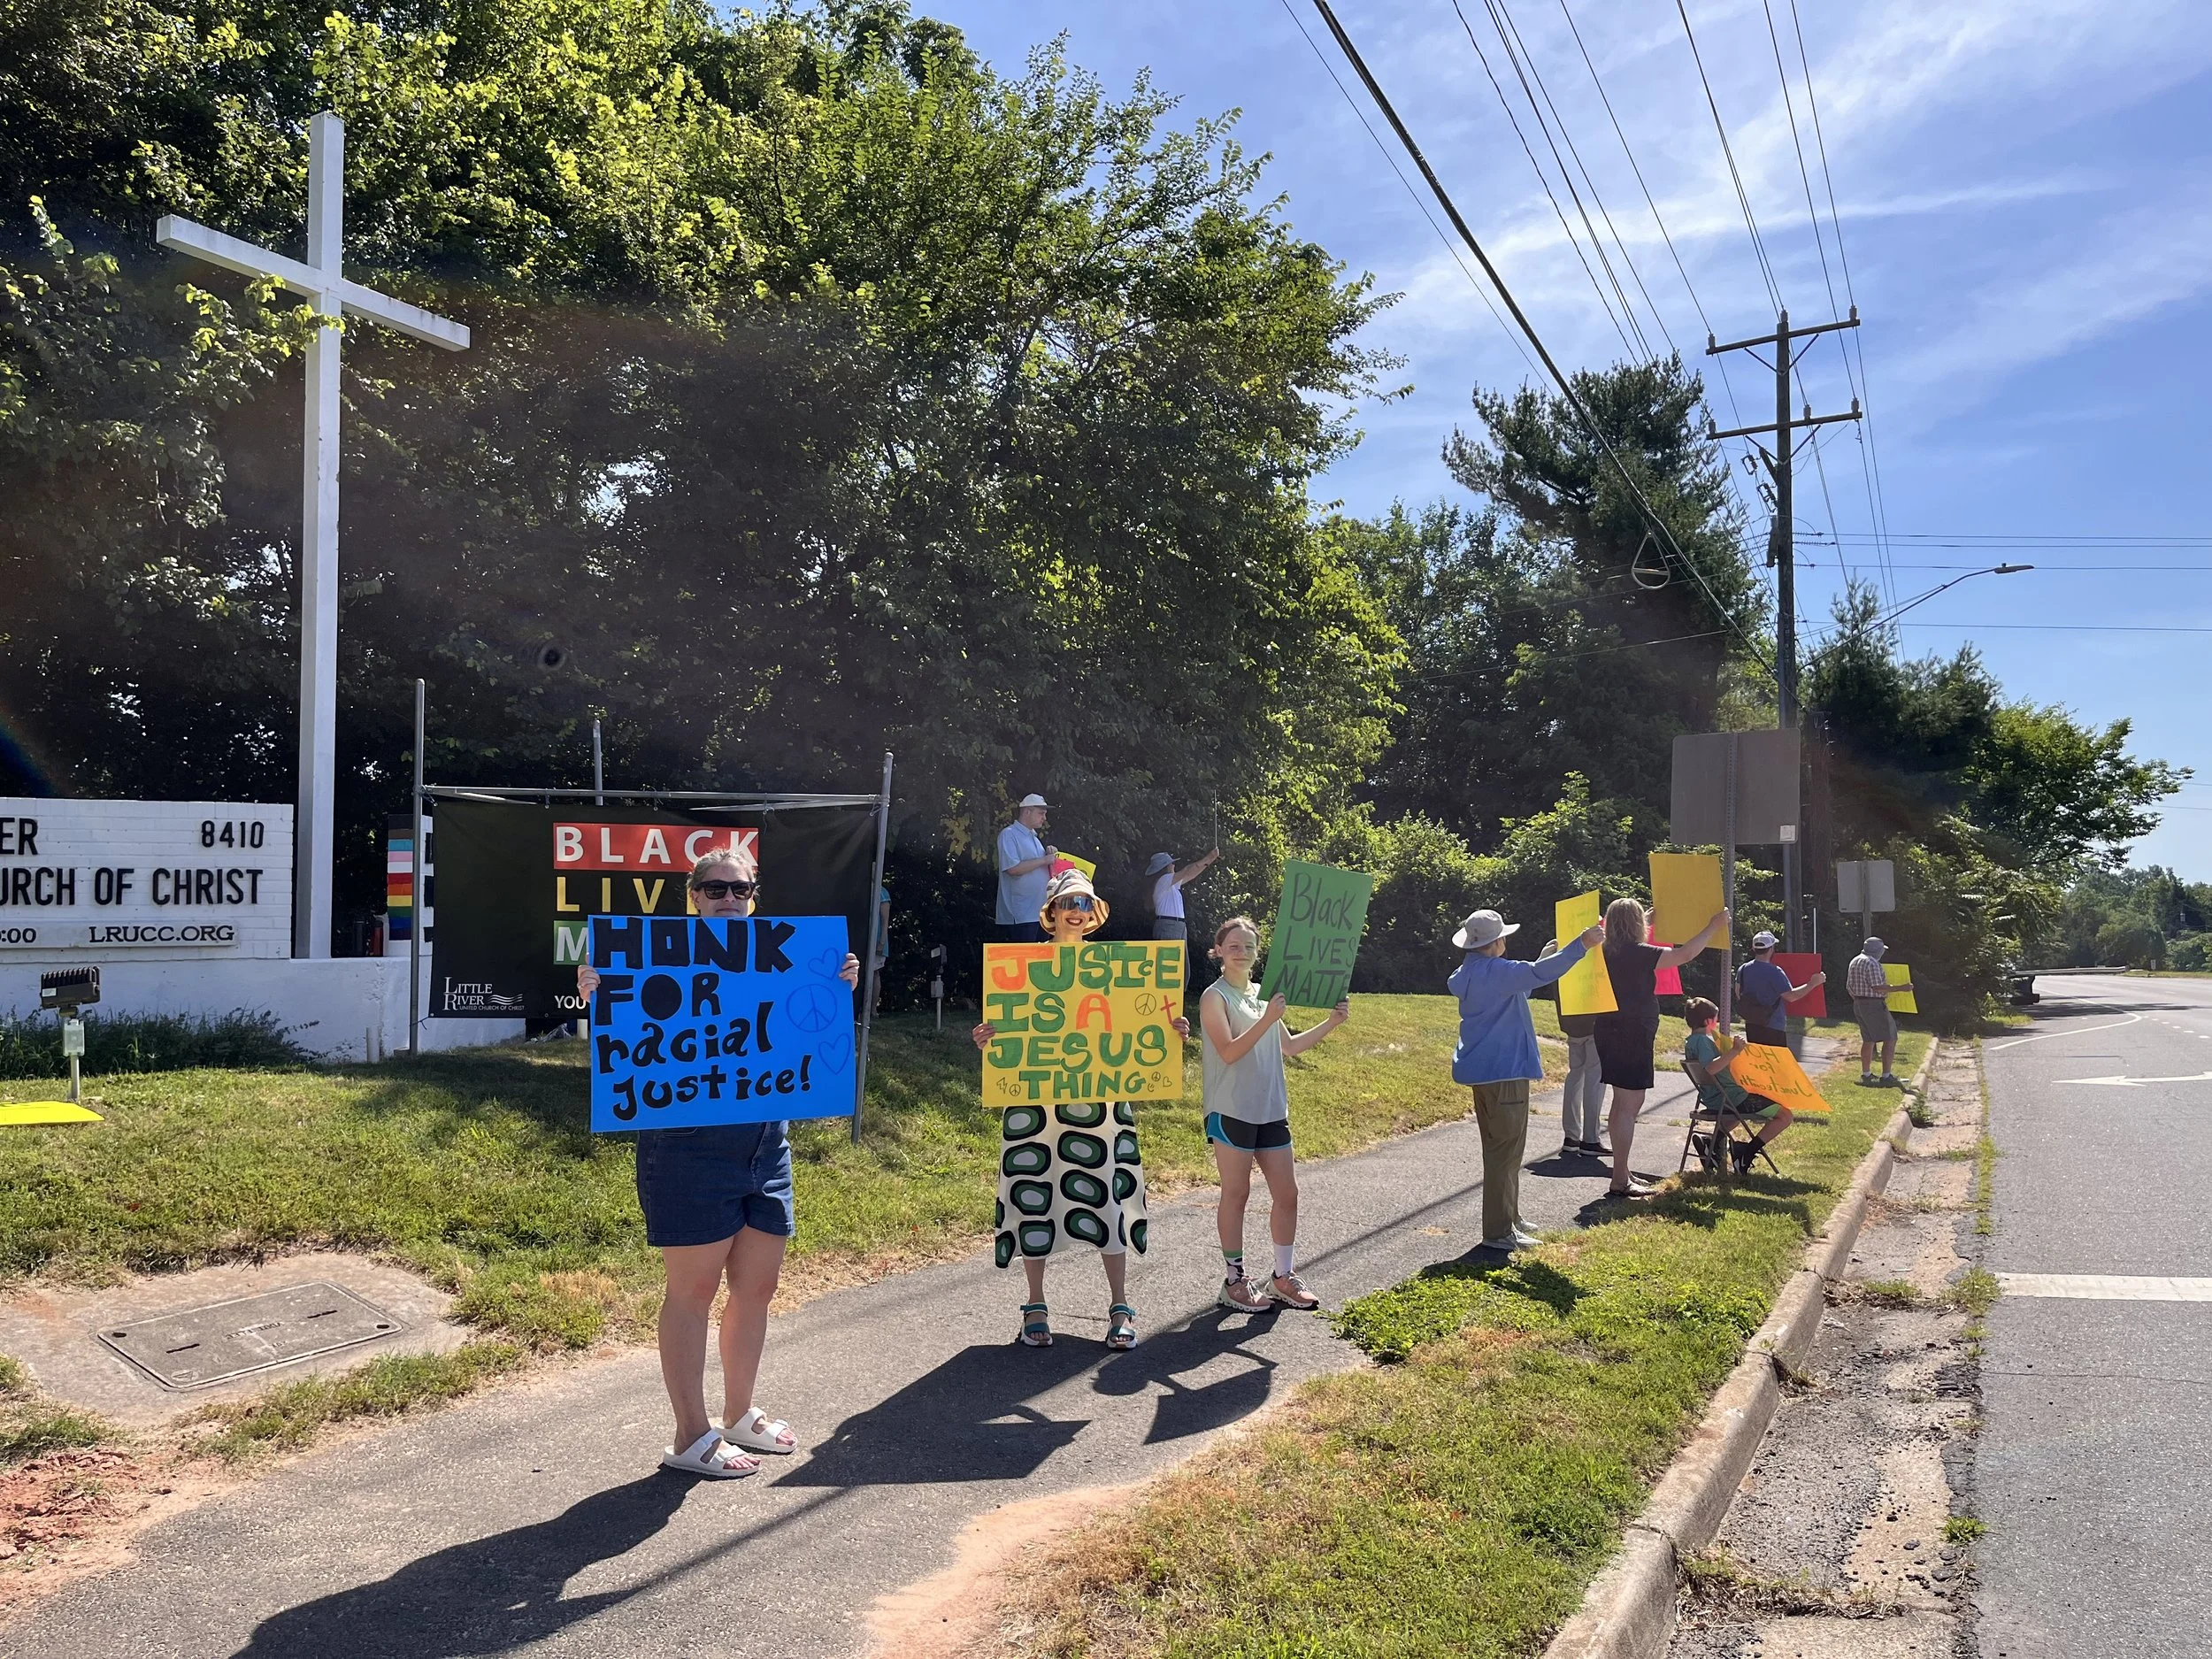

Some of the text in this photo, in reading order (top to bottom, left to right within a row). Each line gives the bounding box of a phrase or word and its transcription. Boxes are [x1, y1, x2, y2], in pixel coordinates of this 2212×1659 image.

[201, 820, 265, 849] 8410
[556, 826, 759, 866] BLACK
[95, 867, 134, 905] OF
[152, 868, 264, 905] CHRIST
[557, 876, 756, 915] LIV
[0, 927, 36, 943] :00
[88, 925, 235, 943] LRUCC.ORG
[593, 918, 796, 973] HONK
[1284, 926, 1356, 968] LIVES
[442, 993, 485, 1010] RIVER
[444, 977, 493, 994] LITTLE
[595, 972, 721, 1026] FOR
[987, 993, 1112, 1033] IS A
[595, 1002, 774, 1074] racial
[987, 1025, 1168, 1073] JESUS
[1019, 1070, 1147, 1100] THING
